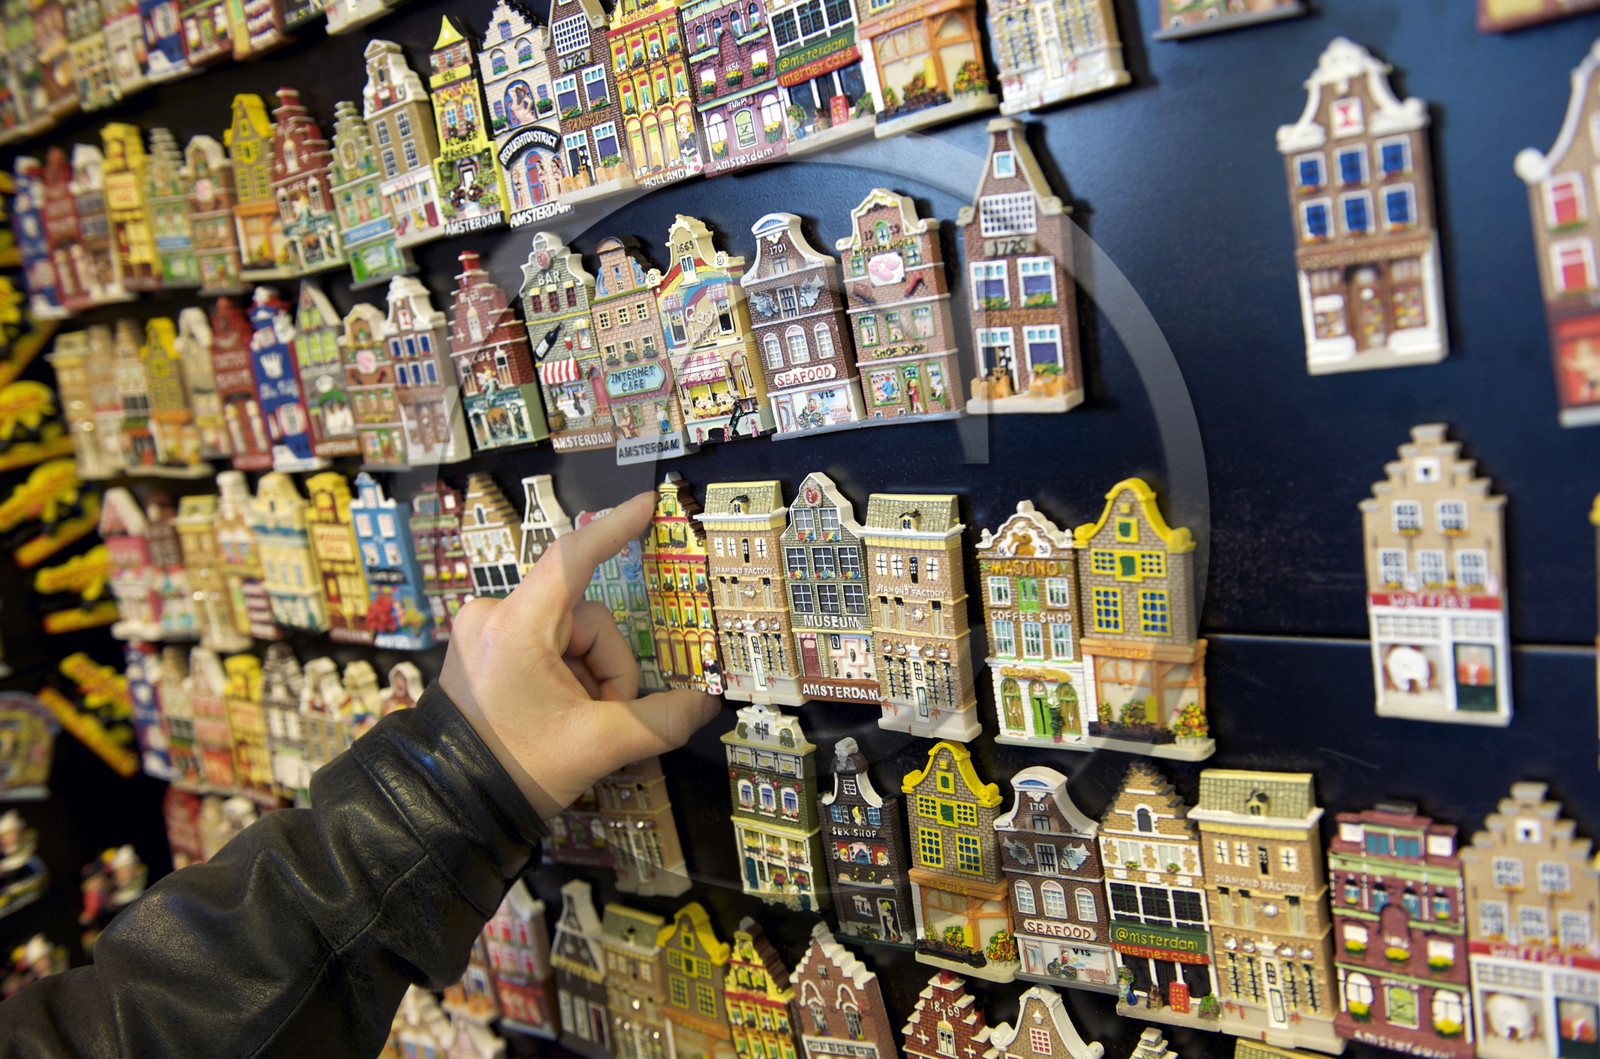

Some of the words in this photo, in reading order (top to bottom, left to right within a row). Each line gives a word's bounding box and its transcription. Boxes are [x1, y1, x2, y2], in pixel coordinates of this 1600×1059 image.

[643, 168, 687, 188] HOLLAND
[445, 212, 502, 236] AMSTERDAM
[769, 243, 787, 256] 1701
[537, 271, 561, 286] BAR
[610, 364, 656, 384] INTERNET
[777, 365, 831, 387] SEAFOOD
[621, 378, 646, 392] CAFE
[818, 389, 836, 401] VIS
[552, 431, 613, 450] AMSTERDAM
[618, 438, 681, 460] AMSTERDAM
[714, 566, 743, 575] DIAMOND
[745, 566, 773, 576] FACTORY
[990, 560, 1060, 576] MASTINO
[875, 584, 910, 595] DIAMOND
[911, 588, 946, 598] FACTORY
[803, 615, 859, 629] MUSEUM
[990, 610, 1034, 622] COFFEE
[1039, 612, 1073, 624] SHOP
[802, 683, 880, 700] AMSTERDAM
[1028, 802, 1050, 812] 1701
[832, 826, 850, 837] SEX
[853, 828, 877, 839] SHOP
[1214, 874, 1260, 889] DIAMOND
[1261, 878, 1309, 893] FACTORY
[1026, 920, 1092, 940] SEAFOOD
[1115, 927, 1199, 951] @msterdam
[1072, 947, 1092, 958] VIS
[1116, 943, 1168, 960] internet
